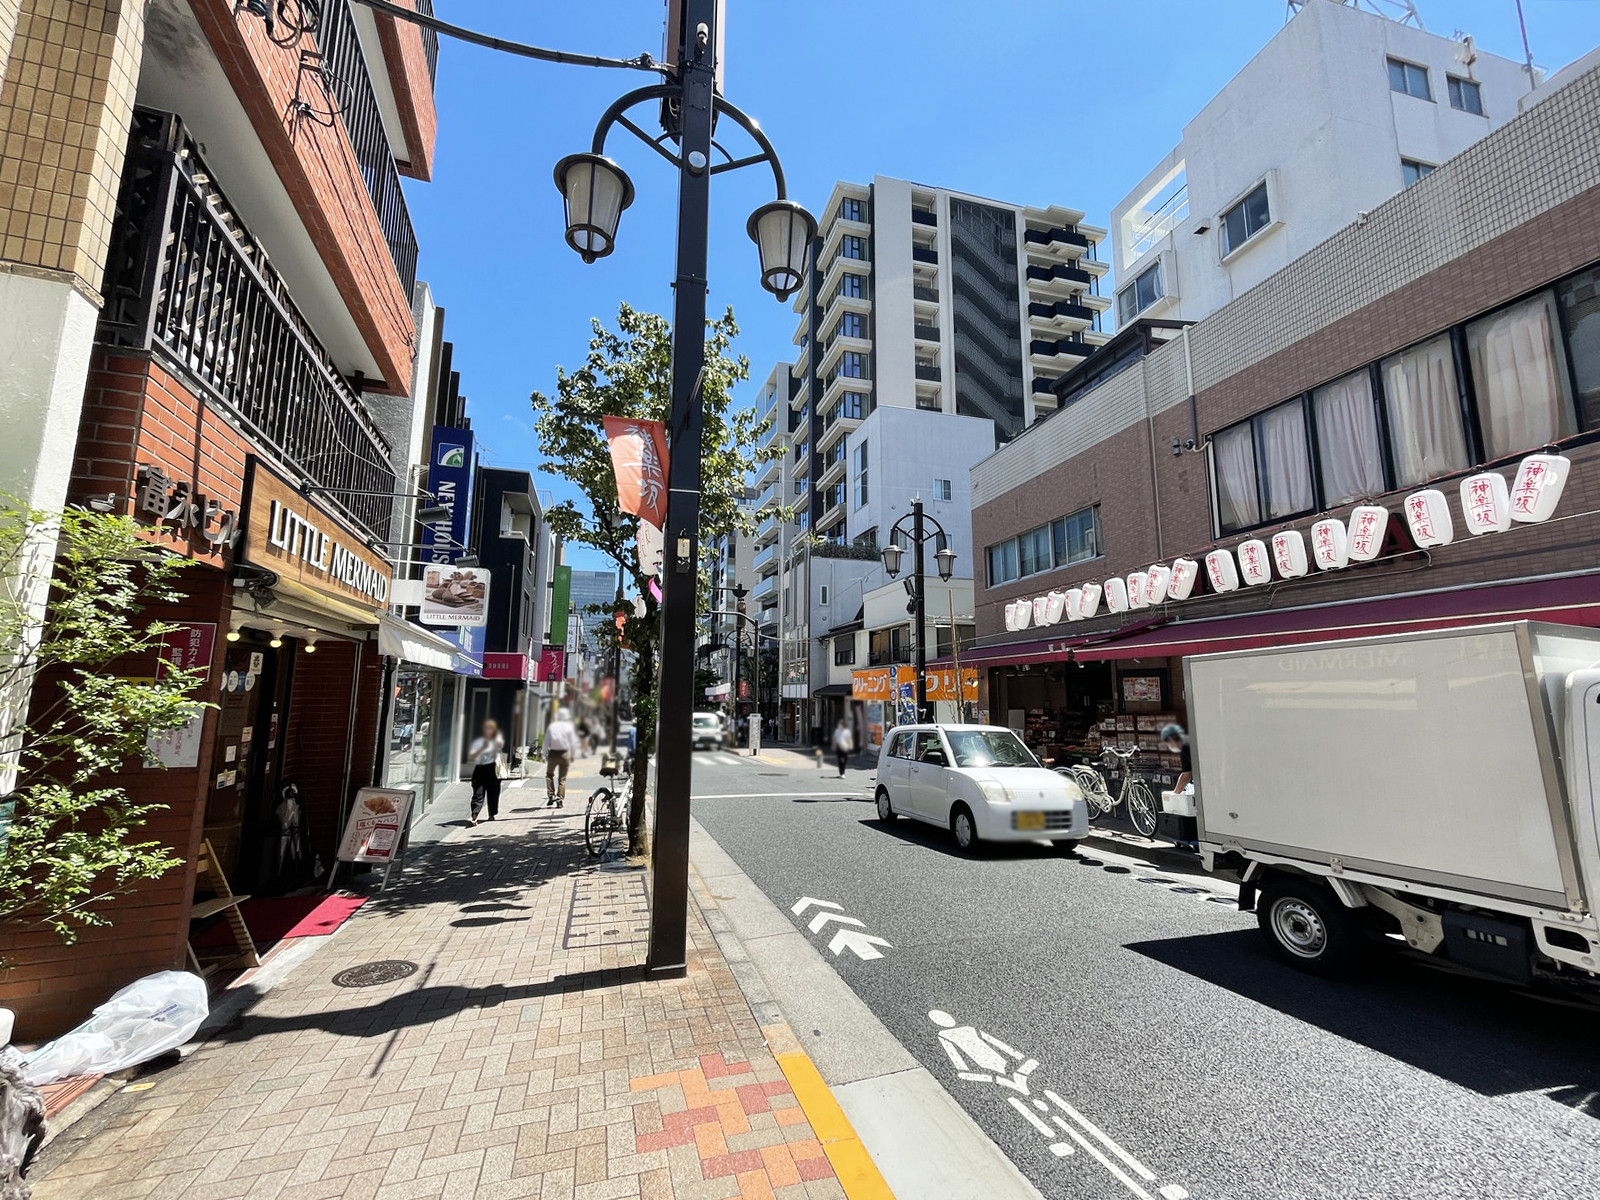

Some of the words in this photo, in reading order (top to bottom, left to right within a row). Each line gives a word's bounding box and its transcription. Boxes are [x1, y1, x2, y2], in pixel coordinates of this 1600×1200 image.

[1472, 481, 1497, 525] 神楽坂
[1515, 463, 1544, 514] 神楽坂
[1354, 513, 1376, 554] 神楽坂
[1409, 498, 1435, 539] 神楽坂
[270, 500, 330, 572] LITTLE
[331, 541, 388, 603] MERMAID
[1244, 545, 1262, 577] 神楽坂
[1274, 536, 1293, 571] 神楽坂
[1316, 525, 1337, 562] 神楽坂
[853, 673, 888, 693] クリーニング
